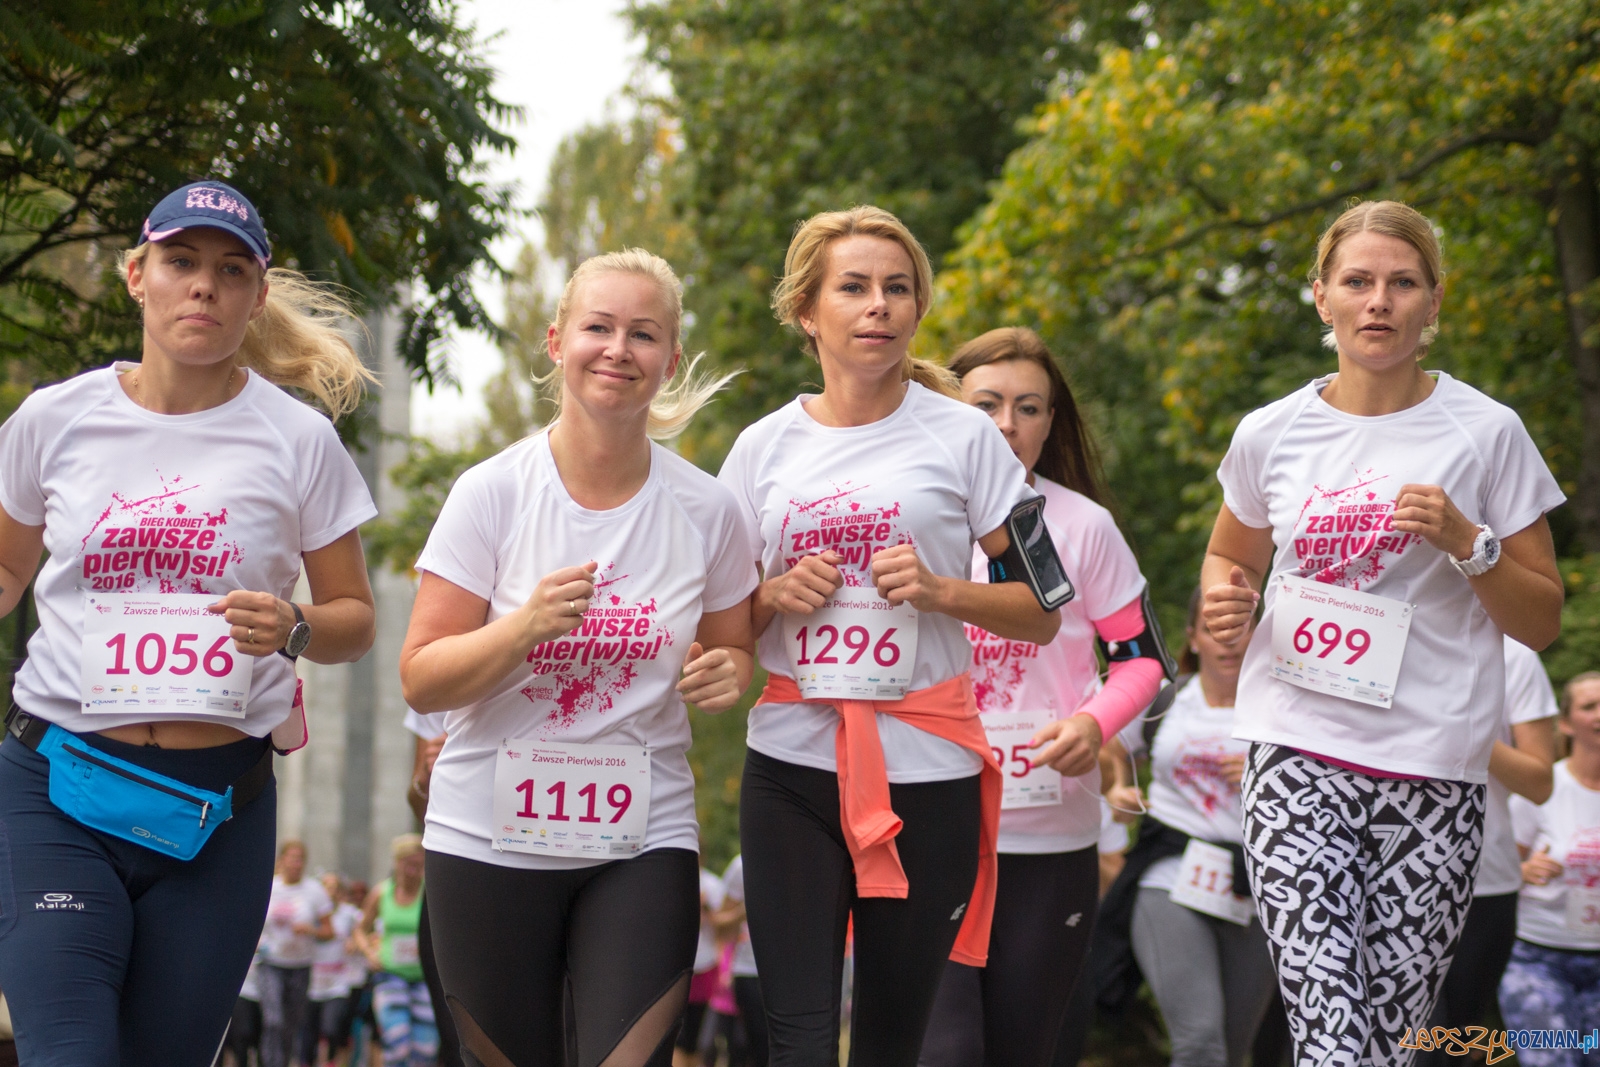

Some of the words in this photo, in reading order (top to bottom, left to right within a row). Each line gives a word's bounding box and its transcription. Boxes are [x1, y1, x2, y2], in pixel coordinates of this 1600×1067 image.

[1338, 504, 1358, 514] BIEG
[1359, 504, 1391, 513] KOBIET
[140, 518, 164, 528] BIEG
[166, 518, 204, 528] KOBIET
[821, 518, 842, 527] BIEG
[844, 514, 879, 524] KOBIET
[1306, 514, 1398, 534] zawsze
[100, 526, 216, 550] zawsze
[792, 522, 890, 552] zawsze
[83, 550, 230, 579] pier(w)si!
[92, 572, 135, 590] 2016
[124, 606, 158, 616] Zawsze
[161, 607, 200, 616] Pier(w)si
[583, 608, 603, 617] BIEG
[604, 608, 638, 618] KOBIET
[834, 600, 869, 610] Pier(w)si
[872, 602, 894, 610] 2016
[1300, 591, 1326, 604] Zawsze
[1328, 597, 1362, 612] Pier(w)si
[1364, 606, 1385, 618] 2016
[570, 618, 650, 638] wsze
[796, 624, 900, 667] 1296
[1293, 617, 1371, 665] 699
[105, 633, 234, 678] 1056
[533, 660, 572, 675] 2016
[532, 754, 564, 764] Zawsze
[567, 756, 603, 767] Pier(w)si
[605, 758, 626, 766] 2016
[515, 779, 632, 824] 1119
